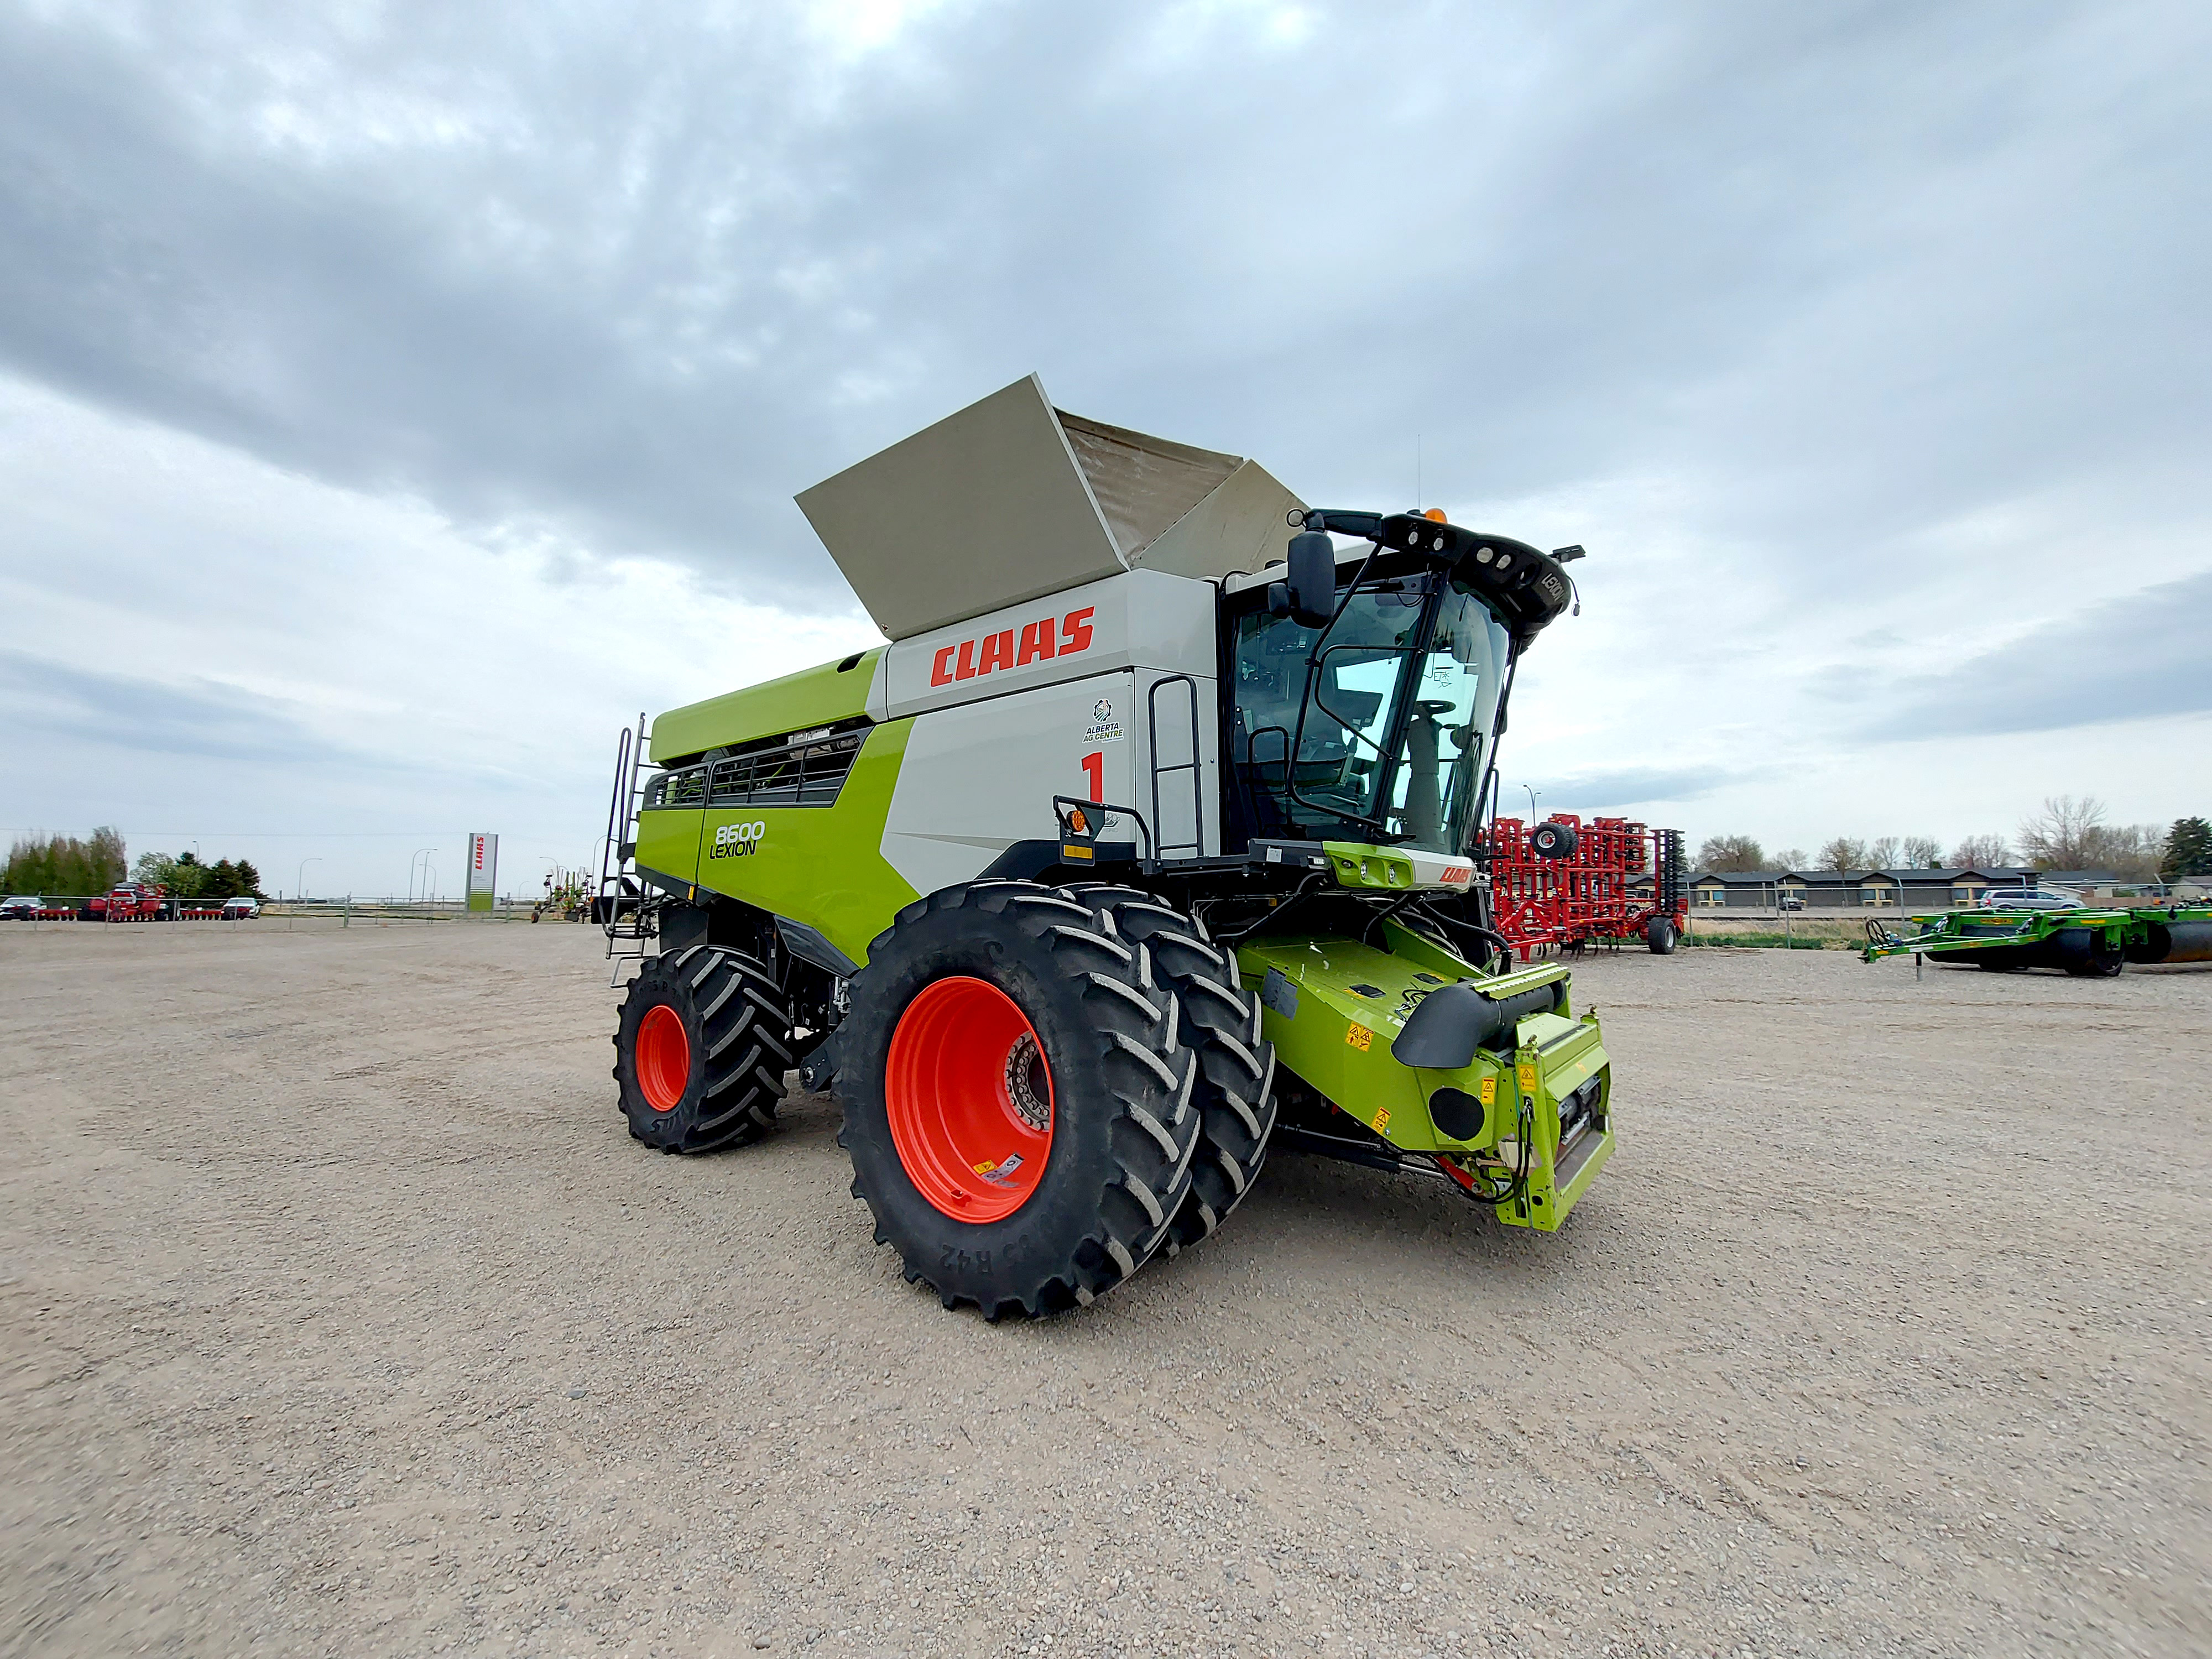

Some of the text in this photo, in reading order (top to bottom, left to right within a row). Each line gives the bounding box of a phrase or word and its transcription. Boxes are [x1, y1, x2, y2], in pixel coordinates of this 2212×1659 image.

[1542, 573, 1564, 602] LEXION
[930, 606, 1095, 687] CLAAS
[1086, 722, 1119, 735] ALBERTA
[1095, 729, 1123, 740] CENTRE
[1081, 752, 1103, 804] 1
[715, 821, 765, 845] 8600
[475, 836, 484, 870] CLAAS
[709, 840, 757, 859] LEXION
